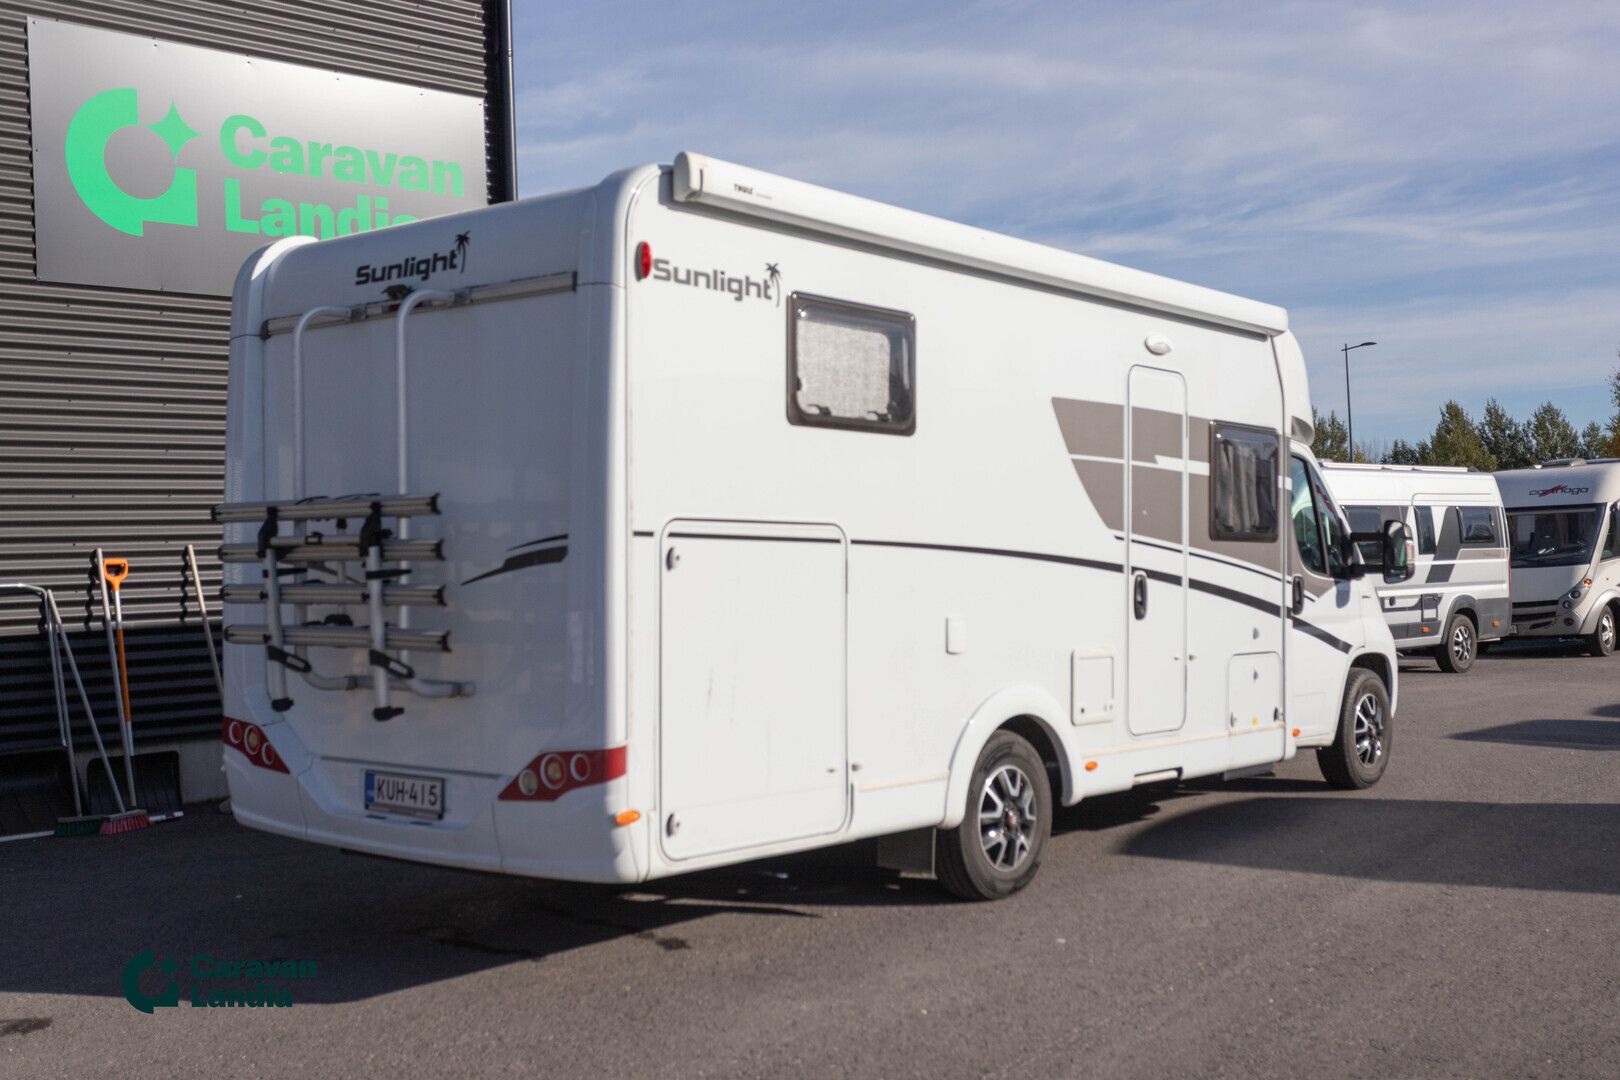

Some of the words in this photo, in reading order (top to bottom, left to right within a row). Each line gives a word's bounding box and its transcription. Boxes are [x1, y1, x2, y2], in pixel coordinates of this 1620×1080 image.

[220, 114, 464, 196] Caravan
[224, 178, 418, 240] Landi
[355, 249, 457, 286] Sunlight
[653, 258, 772, 301] Sunlight
[376, 778, 438, 807] KUH-415
